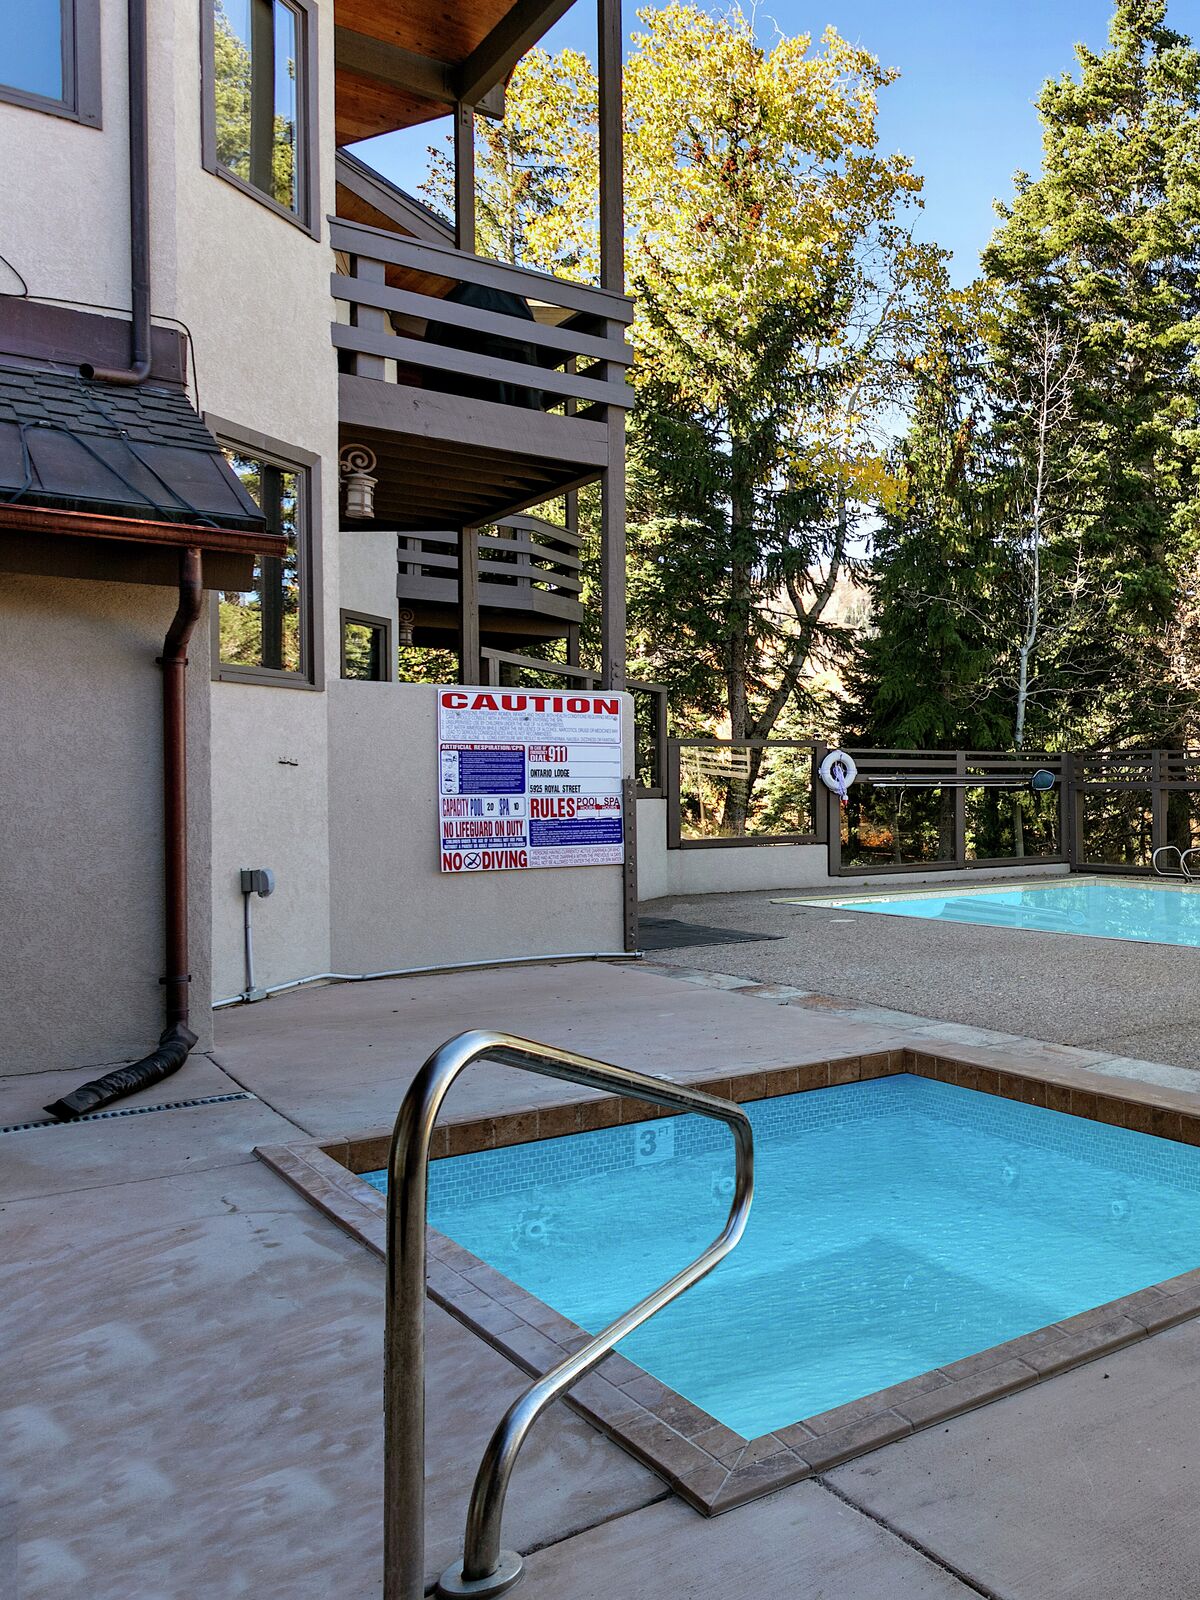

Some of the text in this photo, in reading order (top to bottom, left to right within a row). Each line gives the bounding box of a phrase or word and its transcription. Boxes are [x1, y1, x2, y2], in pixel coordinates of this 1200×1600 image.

[441, 692, 619, 715] CAUTION
[530, 754, 548, 762] DIAL
[548, 746, 566, 762] 911
[530, 768, 552, 778] ONTARIO
[554, 768, 570, 778] LODGE
[529, 784, 543, 793] 5925
[544, 784, 560, 793] ROYAL
[562, 784, 582, 793] STREET
[442, 798, 520, 817] CAPACITY POOL 20 SPA 10
[530, 797, 575, 818] RULES
[576, 797, 620, 806] POOL SPA
[443, 821, 454, 838] NO
[455, 820, 493, 837] LIFEGUARD
[494, 820, 505, 836] ON
[506, 820, 524, 836] DUTY
[443, 849, 528, 872] NO DIVING
[640, 1125, 671, 1156] 3 FT
